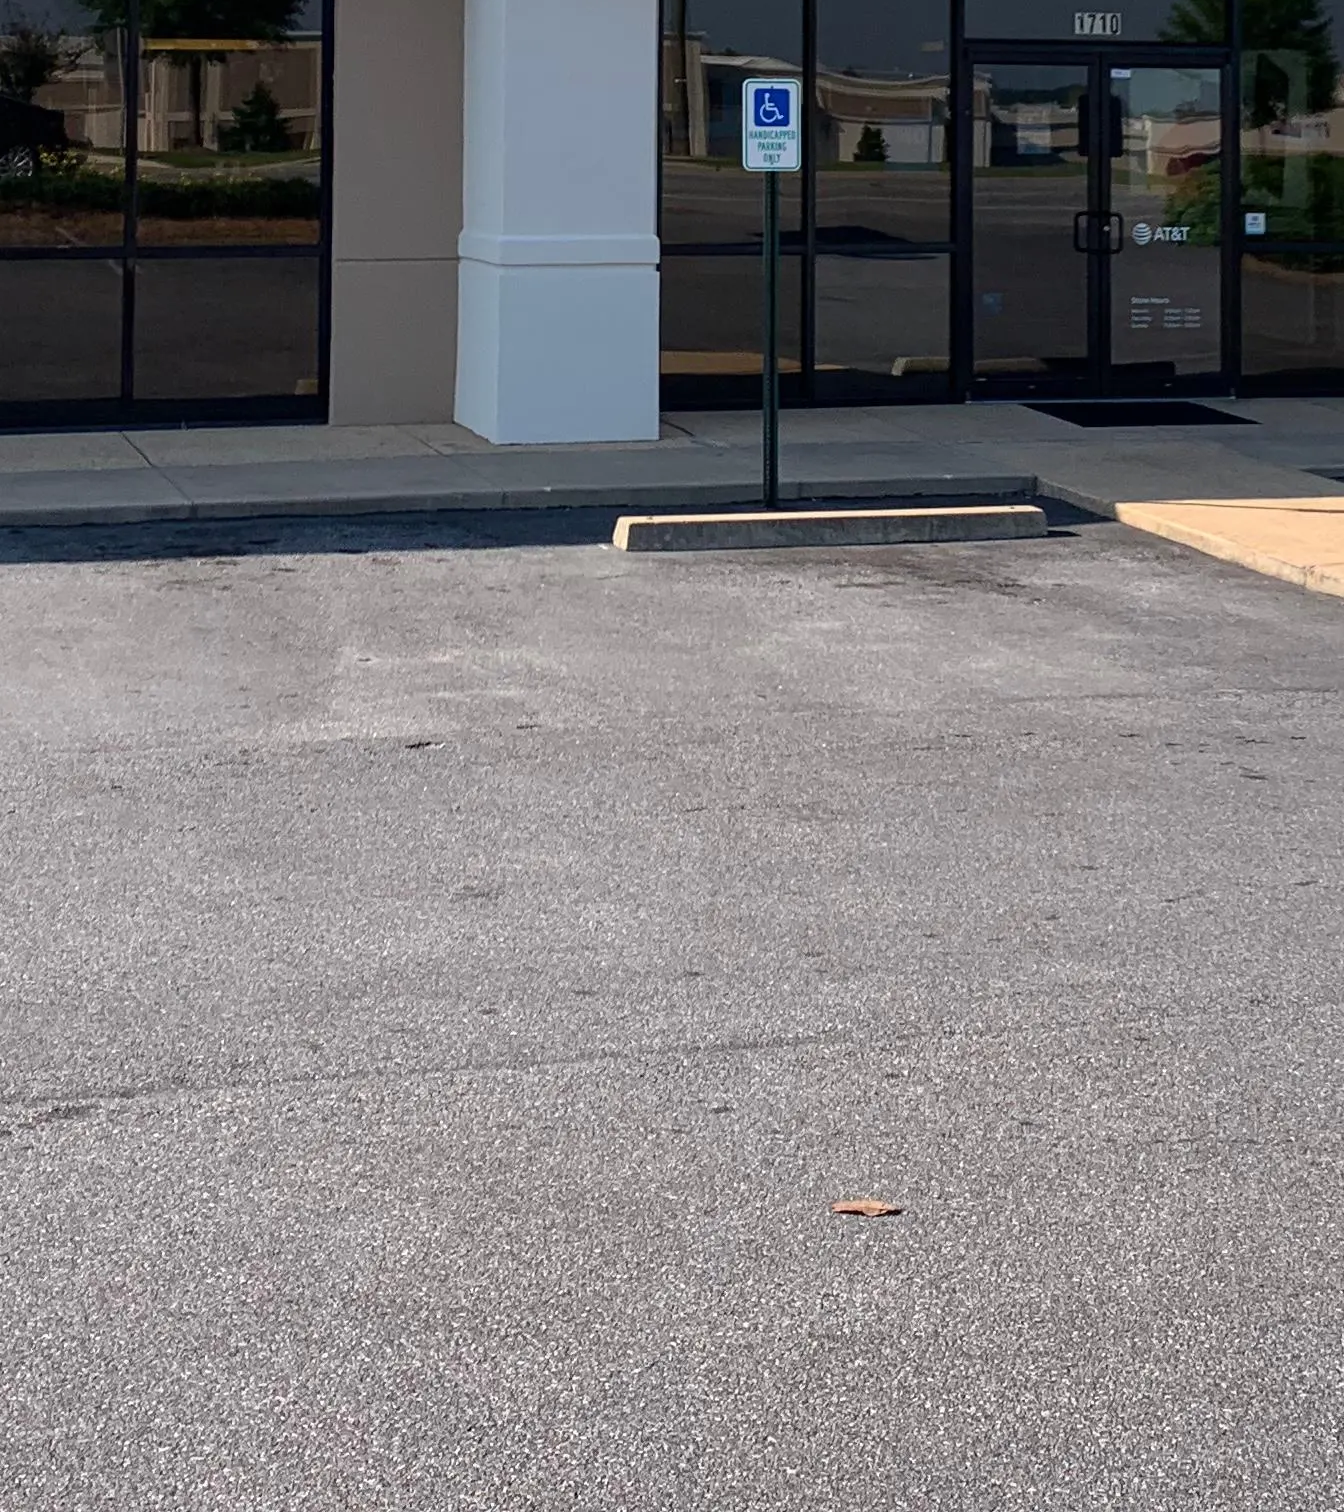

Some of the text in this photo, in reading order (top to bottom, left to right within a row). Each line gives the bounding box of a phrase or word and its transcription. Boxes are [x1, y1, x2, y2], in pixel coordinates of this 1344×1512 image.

[1077, 14, 1119, 34] 1710
[749, 129, 796, 140] HANDICAPPED
[757, 141, 787, 152] PARKING
[763, 153, 781, 163] ONLY
[1153, 227, 1191, 241] AT&T
